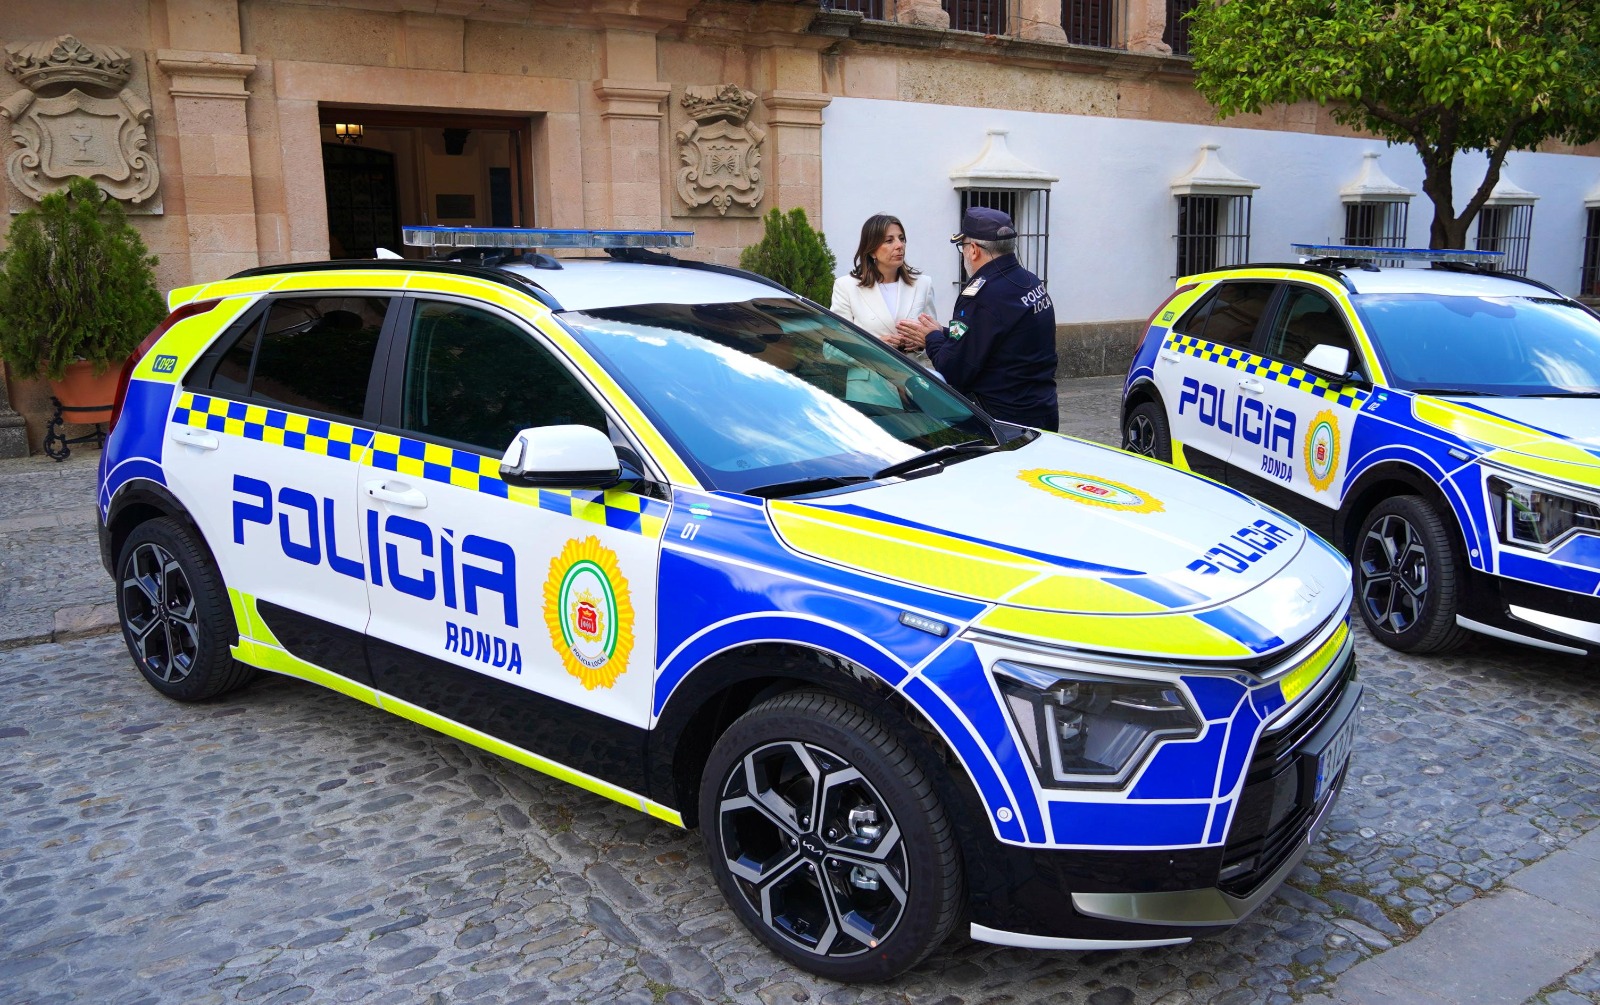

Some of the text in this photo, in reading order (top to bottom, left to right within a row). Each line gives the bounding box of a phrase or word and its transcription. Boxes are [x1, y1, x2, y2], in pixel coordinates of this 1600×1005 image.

[1033, 296, 1051, 314] LOCA
[157, 357, 176, 371] 092
[1261, 454, 1293, 483] RONDA
[680, 522, 700, 541] 01
[445, 621, 522, 675] RONDA
[591, 656, 605, 667] LOCAL
